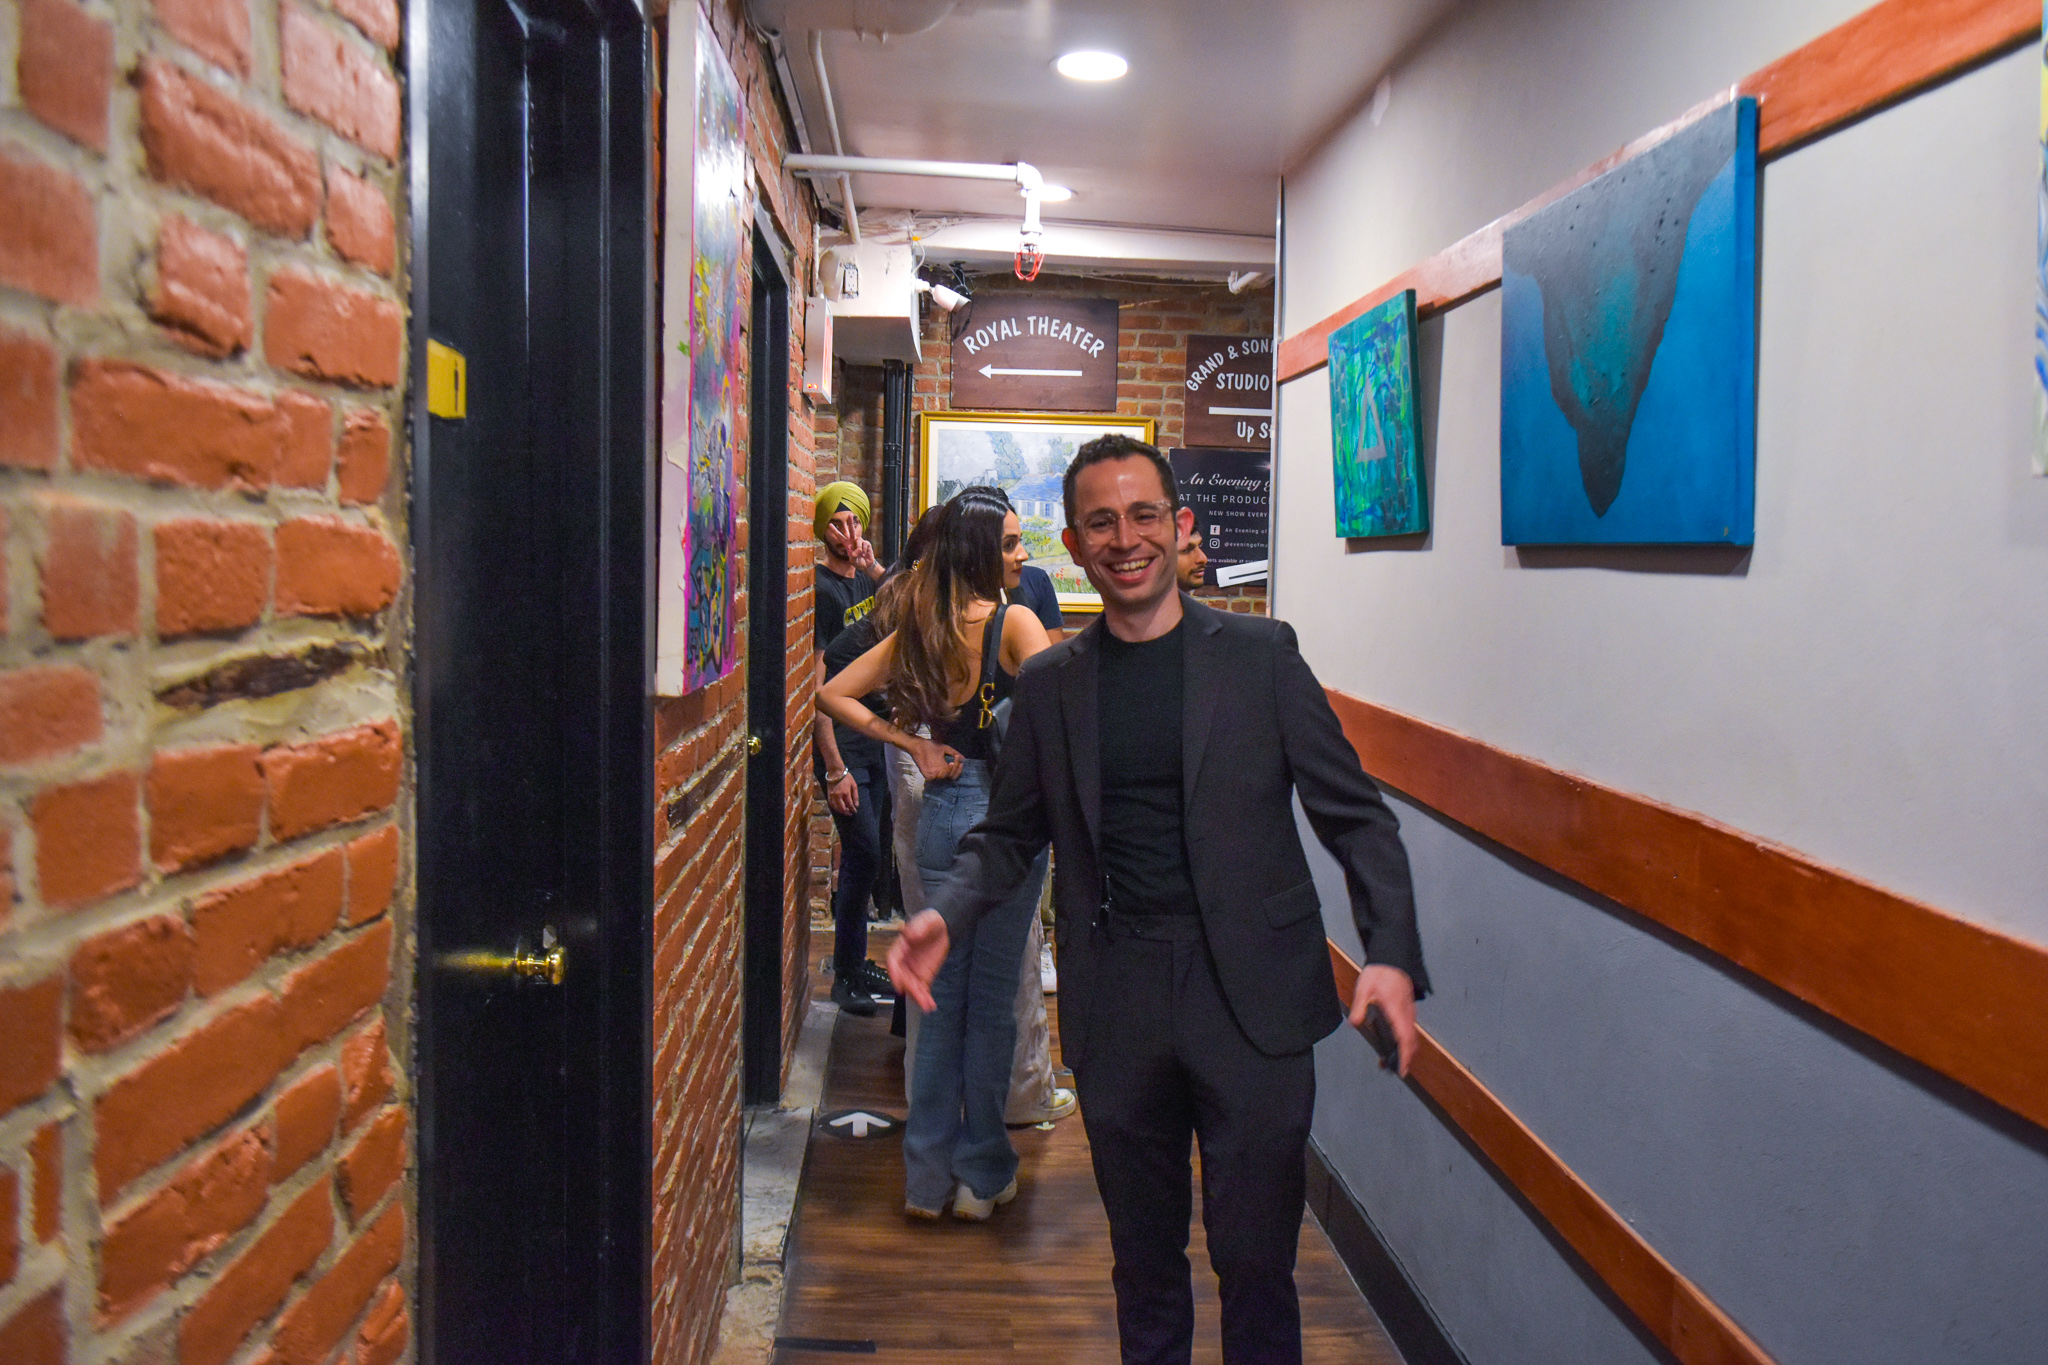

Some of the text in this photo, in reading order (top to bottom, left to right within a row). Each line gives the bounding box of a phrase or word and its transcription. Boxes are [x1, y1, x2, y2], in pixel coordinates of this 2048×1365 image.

[963, 316, 1105, 358] ROYAL THEATER
[1186, 352, 1224, 391] GRAND
[1227, 345, 1239, 359] &
[1216, 372, 1270, 391] STUDIO
[1236, 421, 1255, 443] Up
[1180, 472, 1204, 485] An
[1208, 473, 1262, 492] Evening
[1179, 493, 1270, 505] AT THE PRODUC
[1234, 527, 1259, 535] Evening
